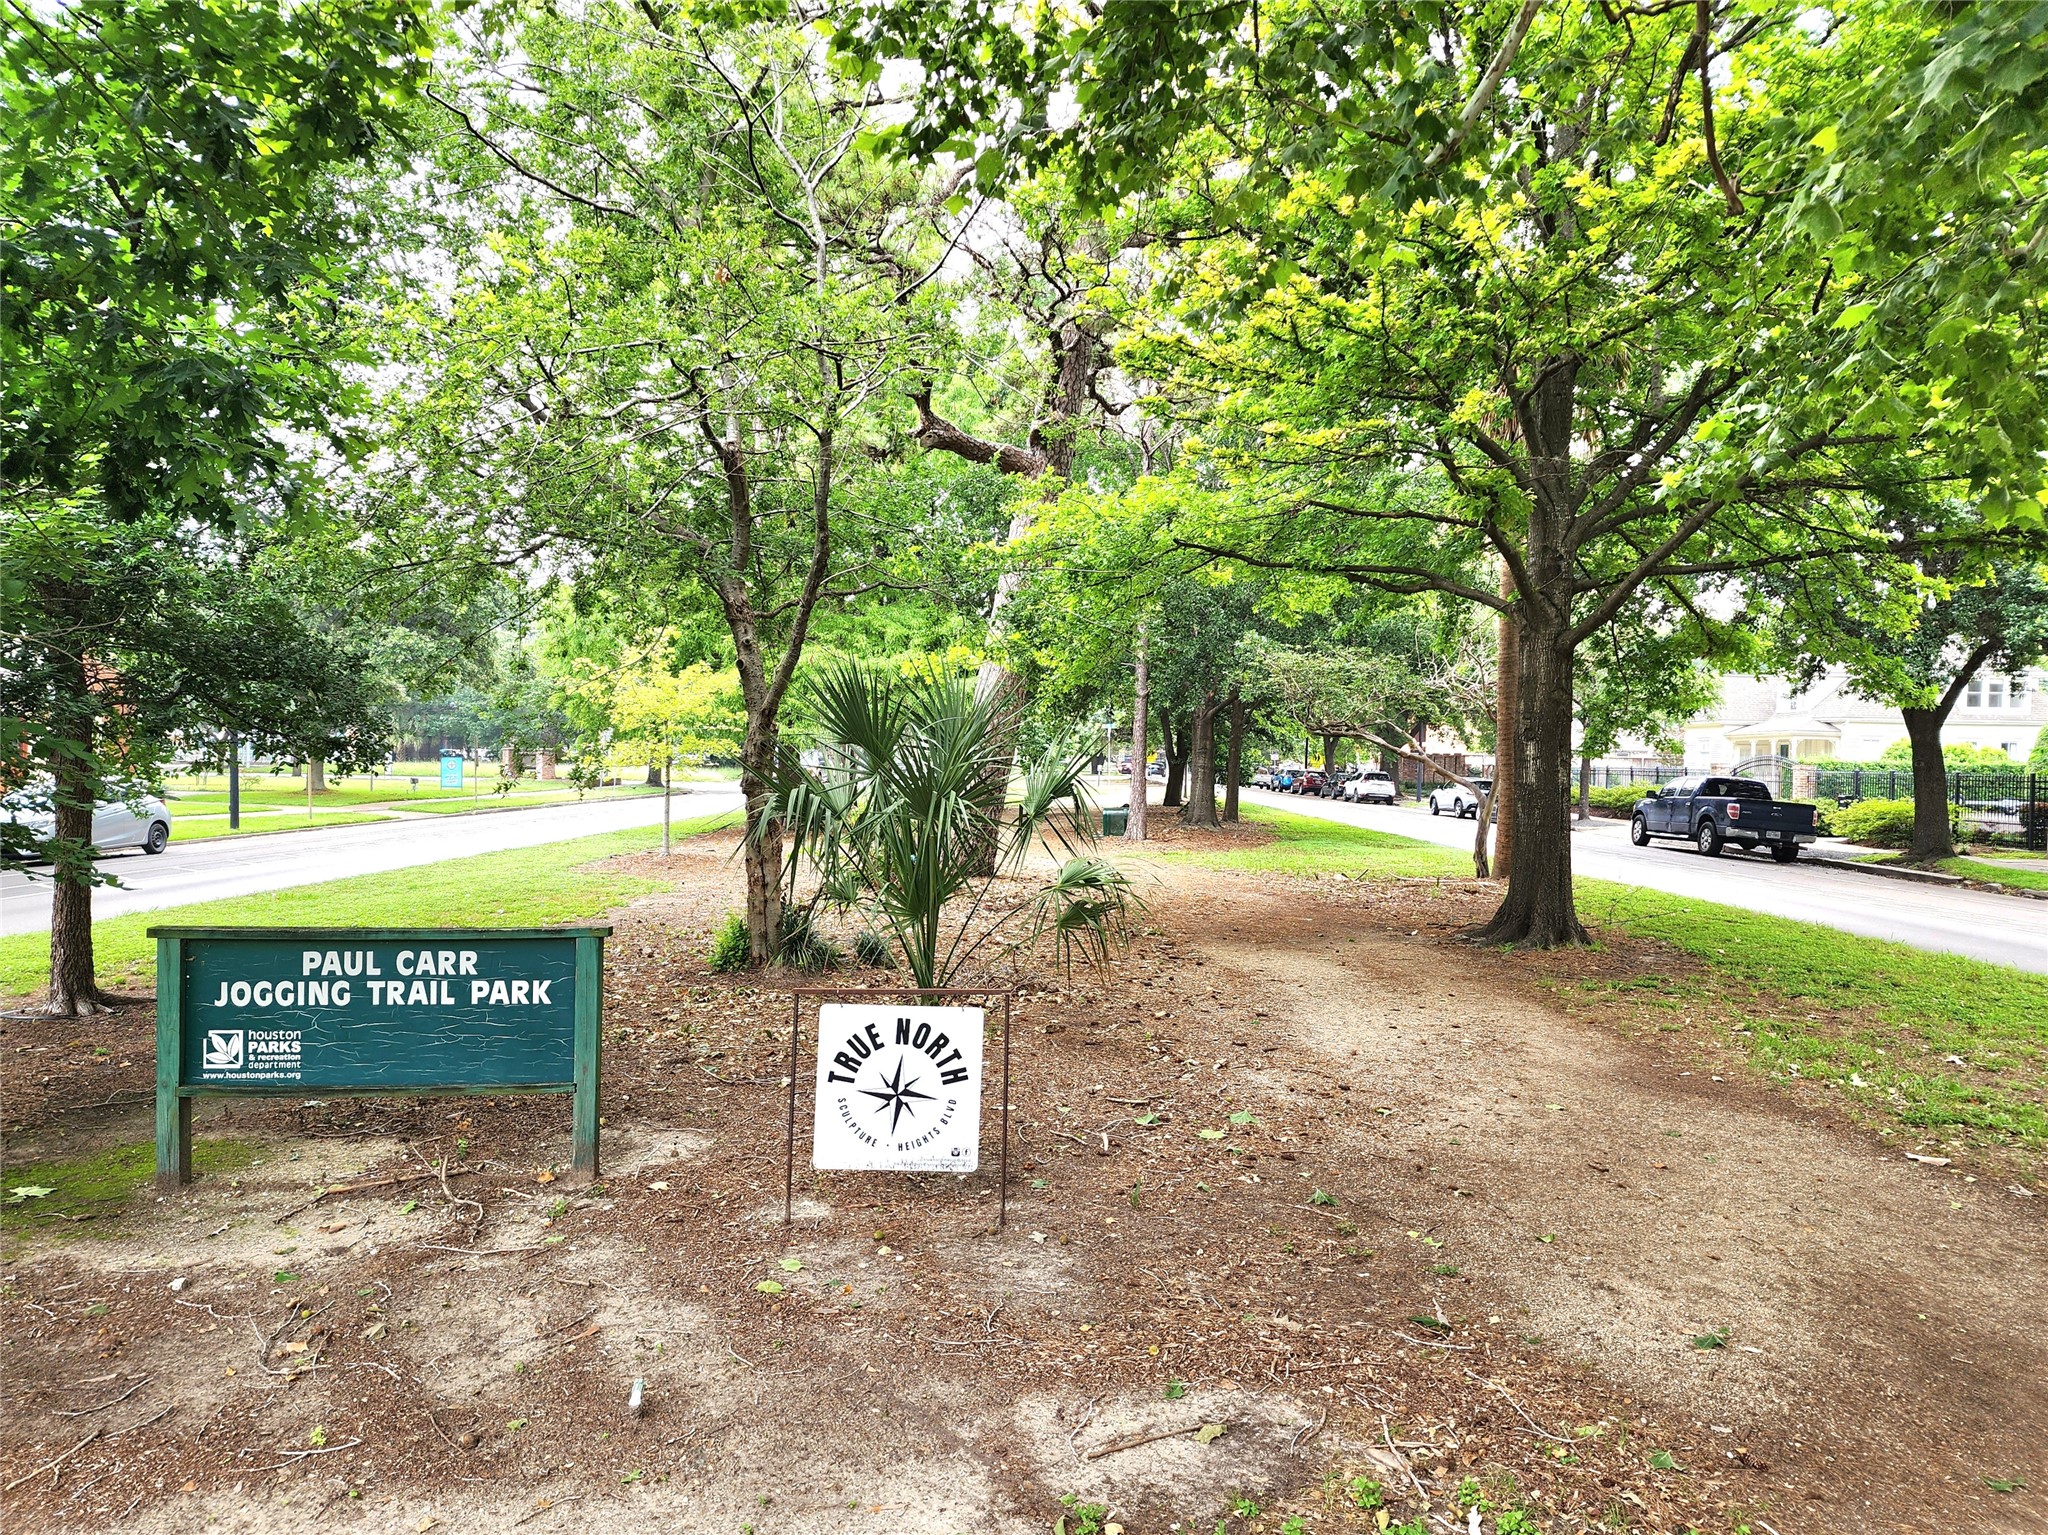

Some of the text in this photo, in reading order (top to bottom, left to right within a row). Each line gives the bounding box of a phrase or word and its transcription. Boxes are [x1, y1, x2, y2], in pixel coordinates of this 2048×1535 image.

[302, 950, 478, 976] PAUL CARR
[214, 979, 552, 1007] JOGGING TRAIL PARK
[248, 1029, 301, 1040] houston
[248, 1041, 301, 1053] PARKS
[827, 1017, 969, 1086] TRUE NORTH
[257, 1053, 301, 1061] recreation
[248, 1061, 301, 1070] department
[202, 1071, 301, 1080] www.houstonparks.org
[837, 1097, 957, 1152] SCULPTURE HEIGHTS BLVD
